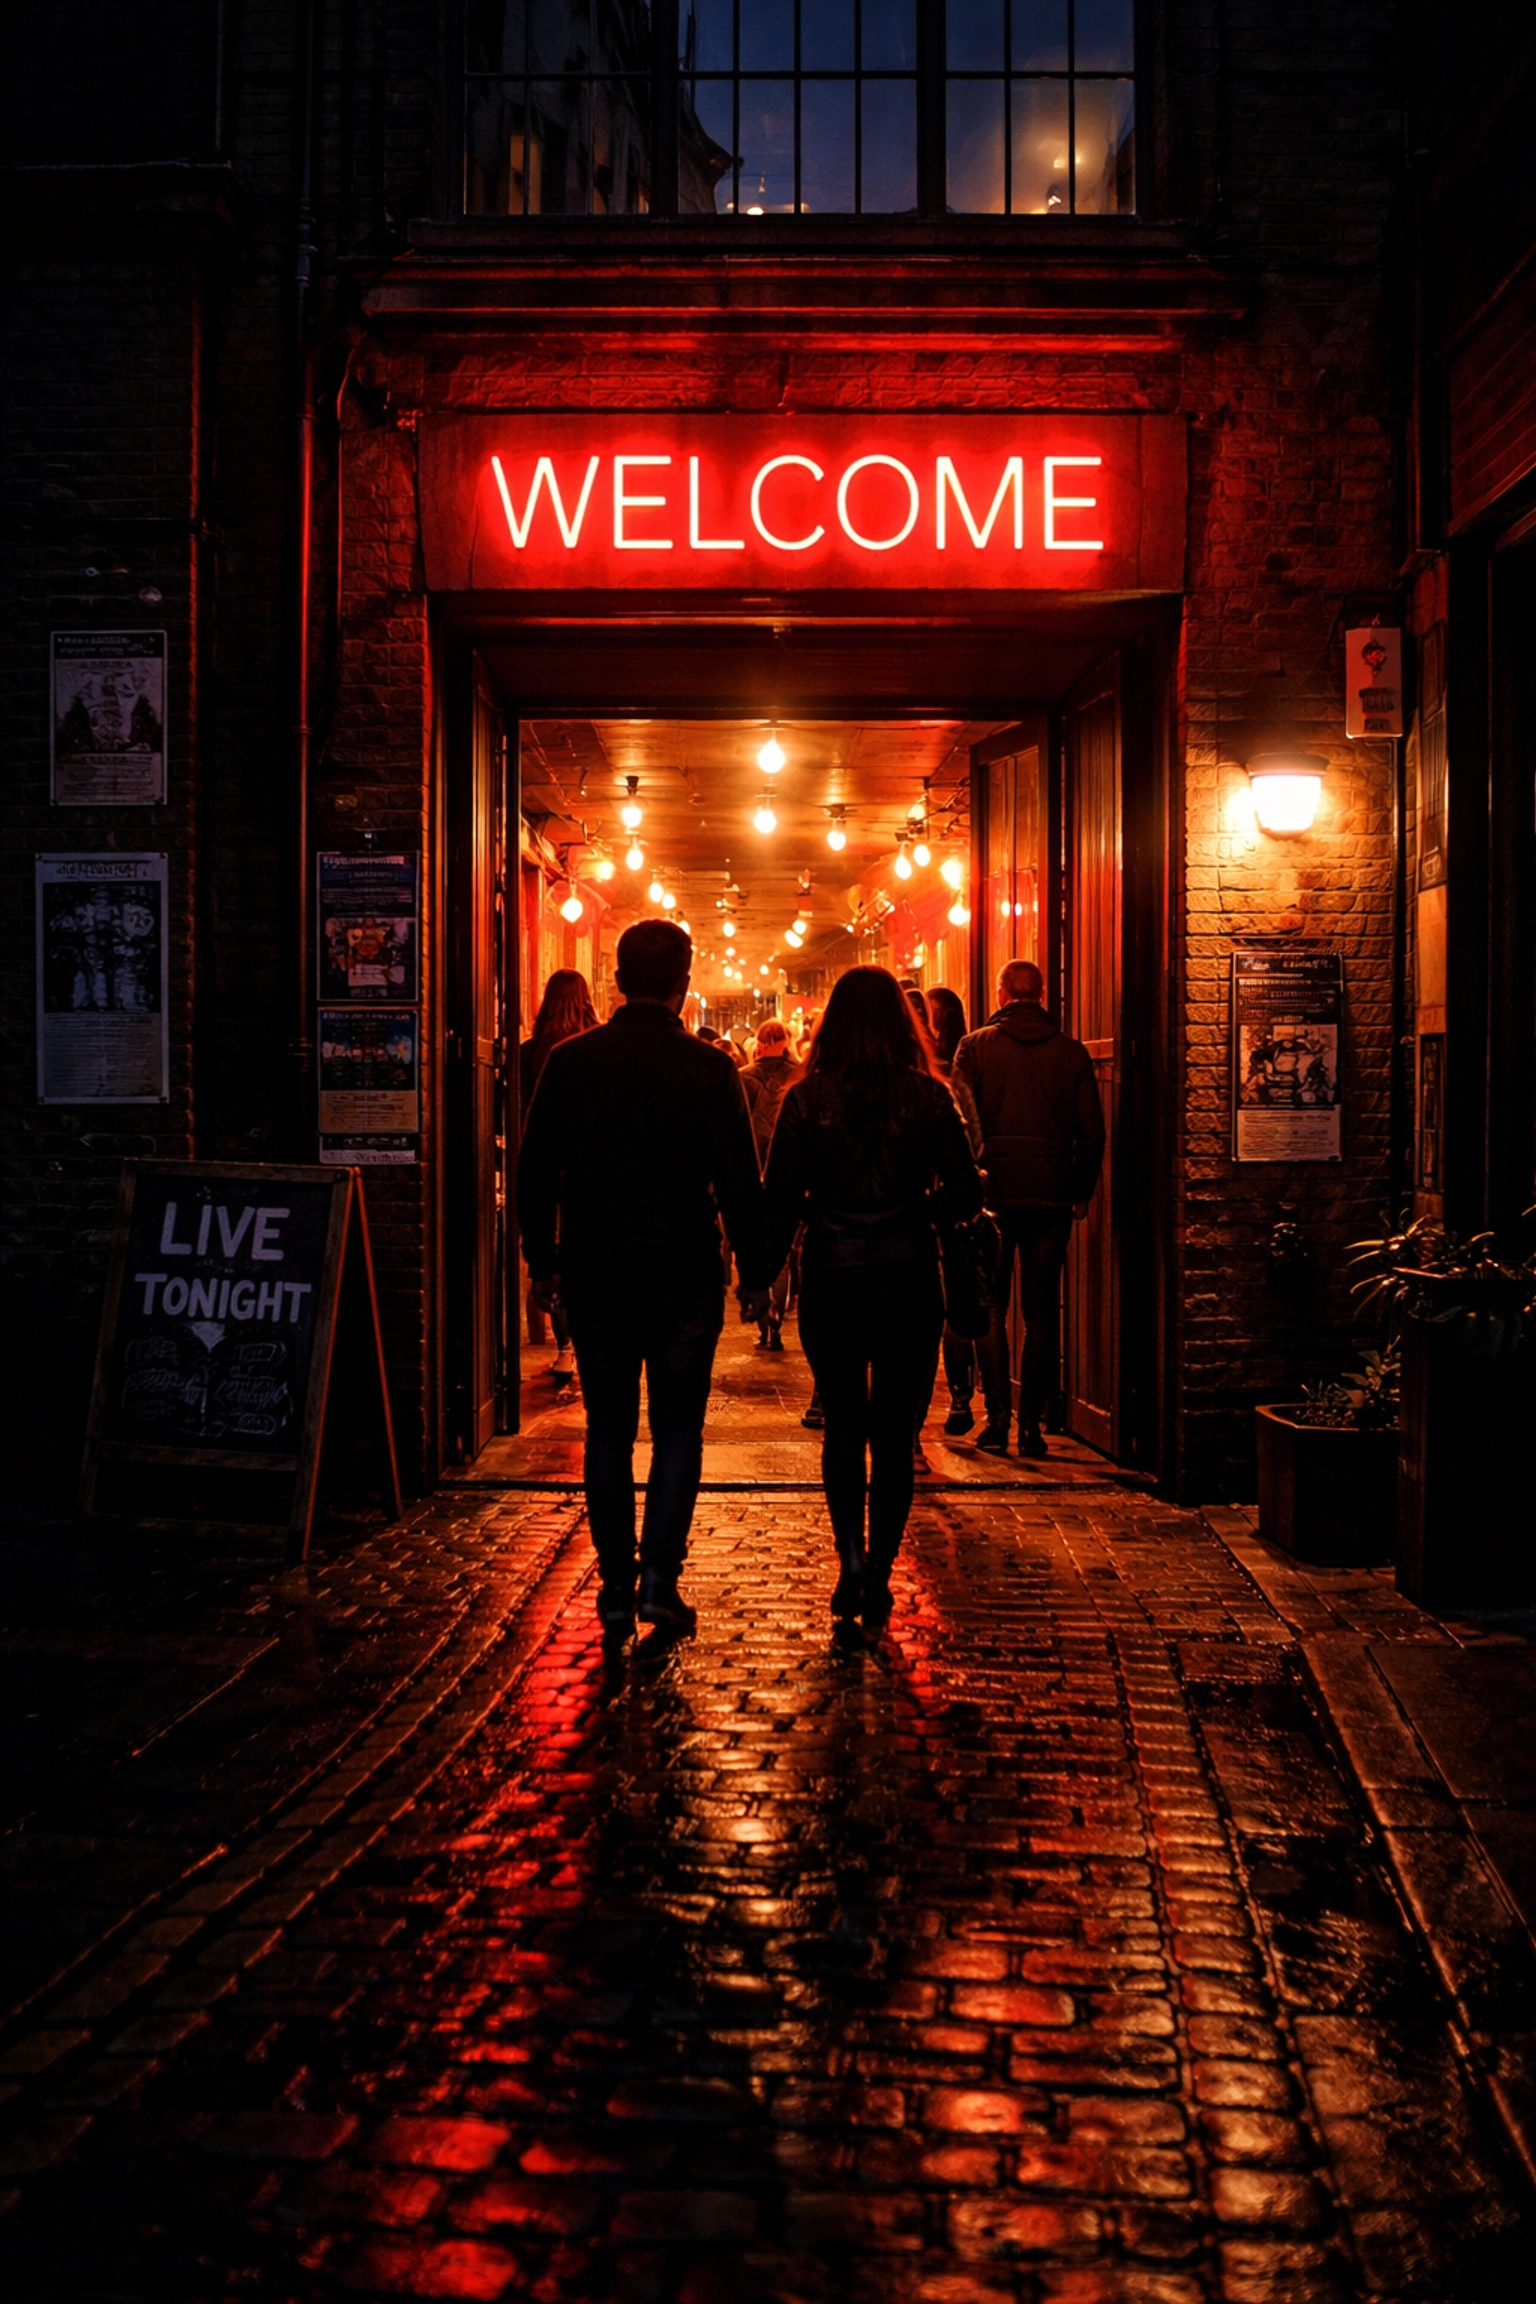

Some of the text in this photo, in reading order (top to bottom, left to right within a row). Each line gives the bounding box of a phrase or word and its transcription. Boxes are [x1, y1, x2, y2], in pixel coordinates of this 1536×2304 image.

[491, 454, 1104, 550] WELCOME
[160, 1201, 291, 1261] LIVE
[134, 1272, 312, 1323] TONIGHT
